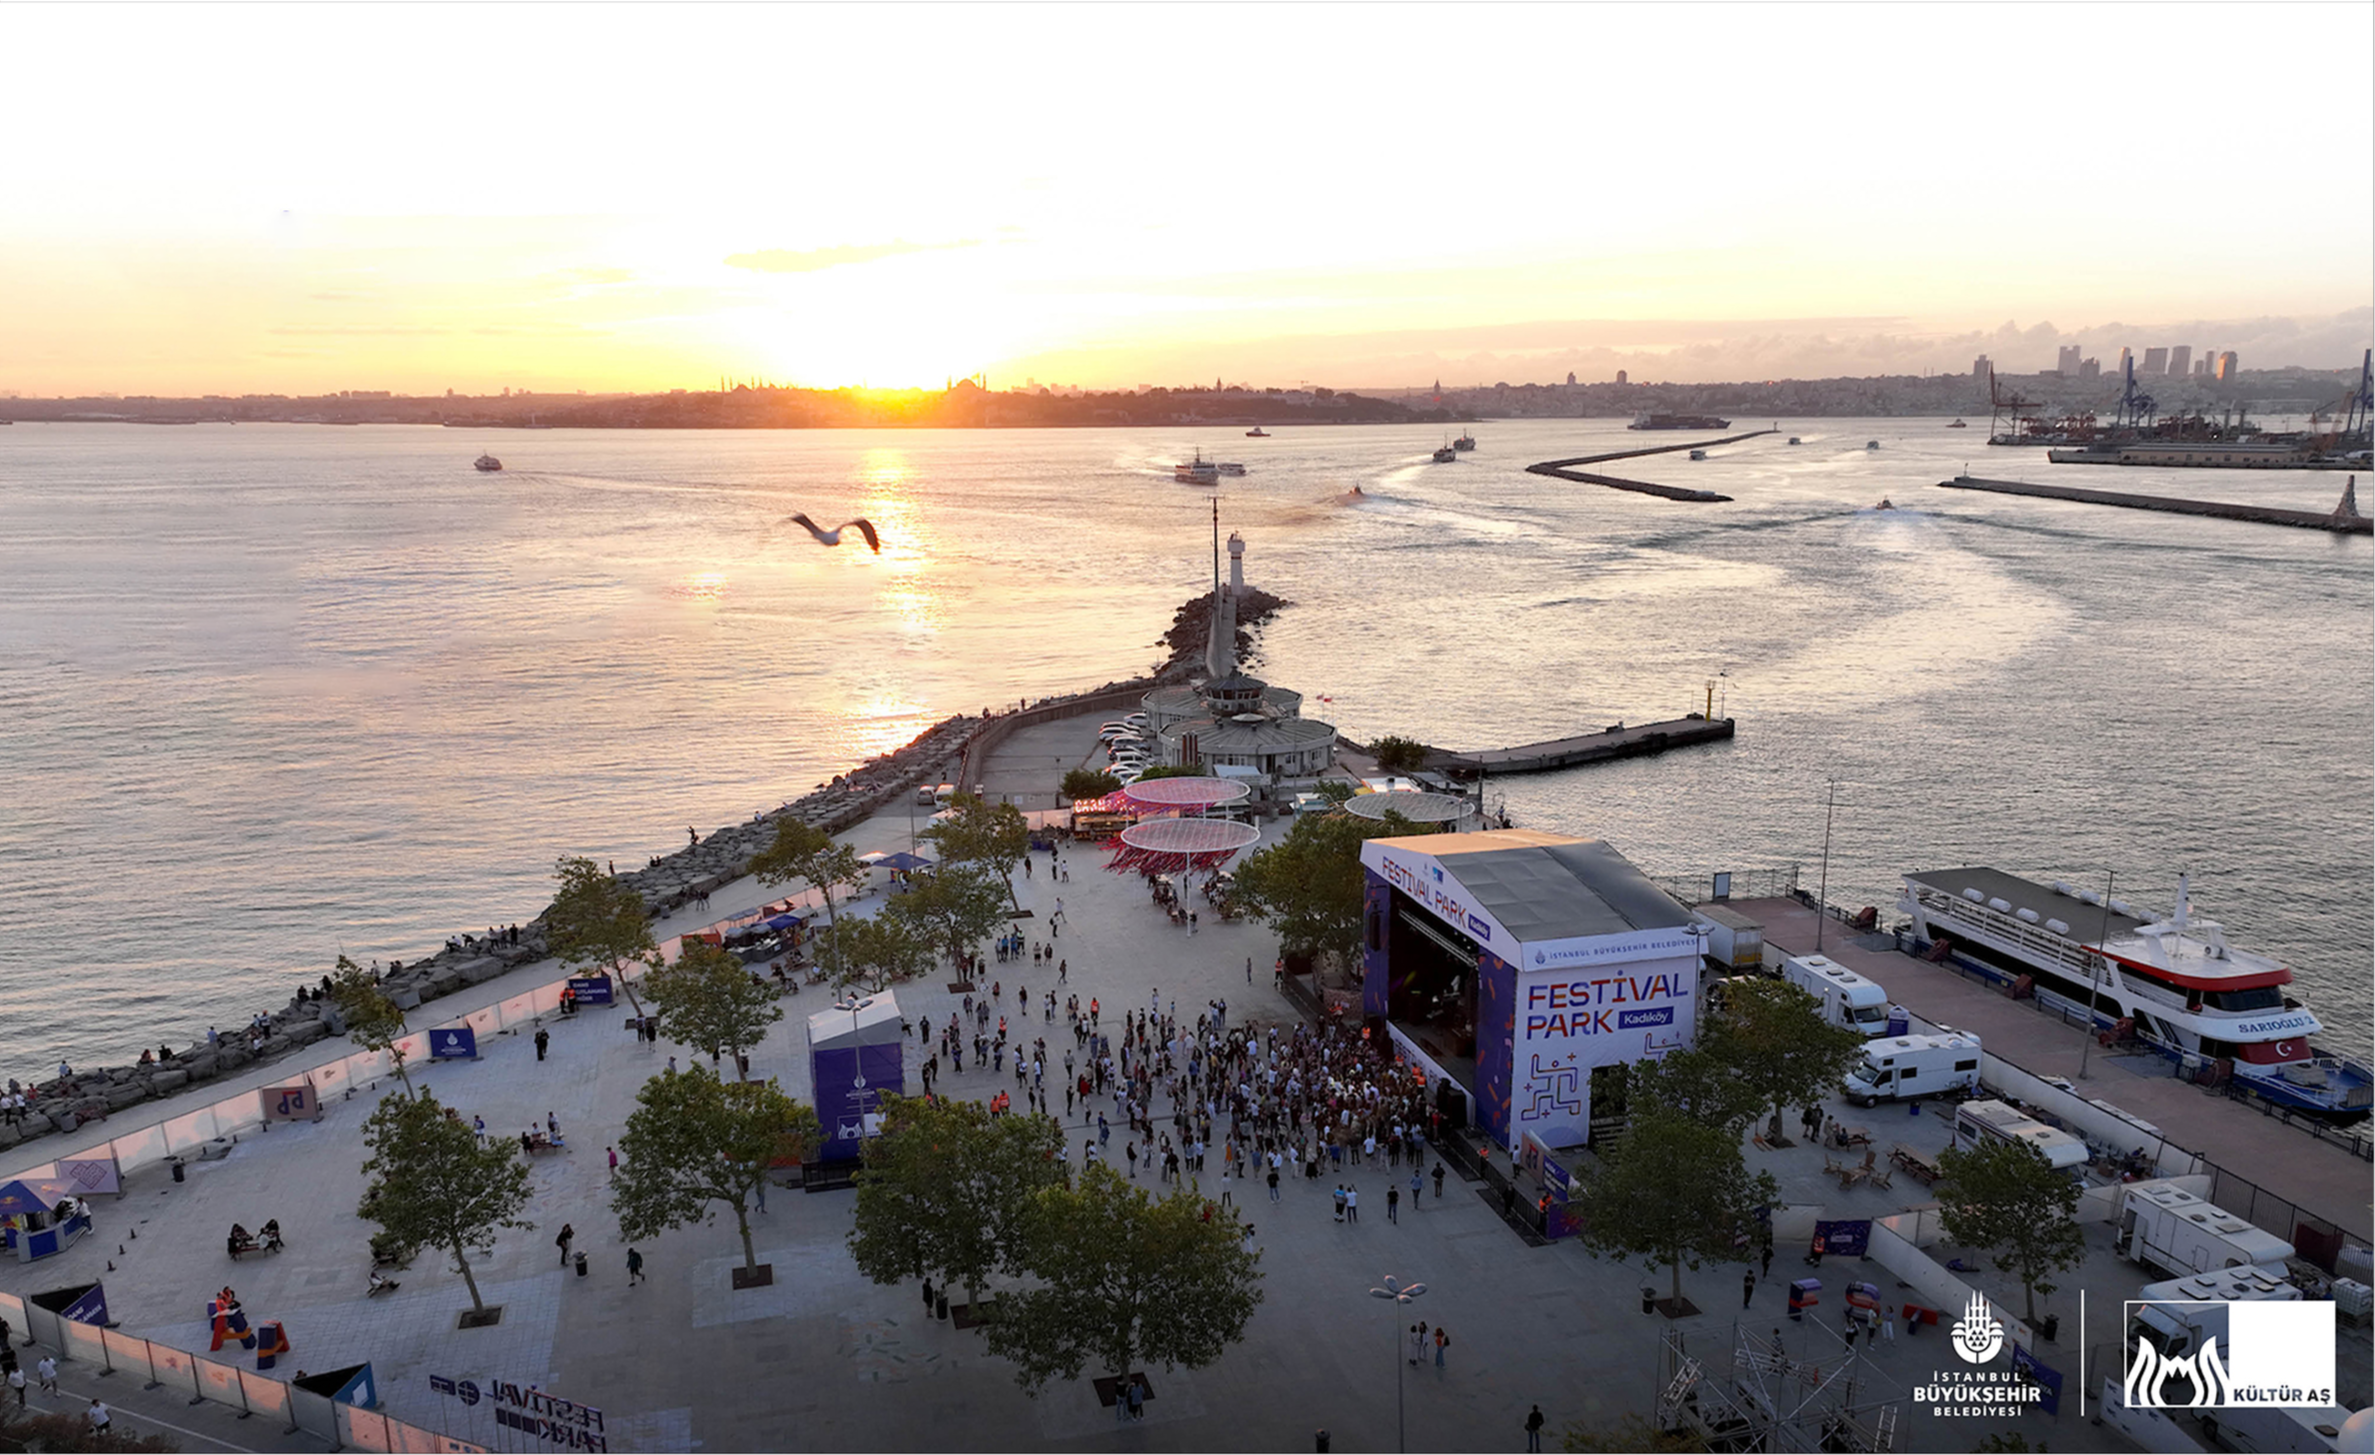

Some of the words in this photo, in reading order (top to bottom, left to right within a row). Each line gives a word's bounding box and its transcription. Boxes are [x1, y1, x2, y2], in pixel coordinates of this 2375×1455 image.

[1382, 856, 1433, 907] FESTİVAL
[1435, 890, 1467, 928] PARK
[1550, 950, 1590, 960] İSTANBUL
[1594, 943, 1648, 955] BÜYÜKŞEHİR
[1651, 939, 1698, 950] BELEDİYES
[1528, 970, 1689, 1010] FESTİVAL
[1527, 1008, 1614, 1040] PARK
[1624, 1011, 1669, 1026] Kadıköy
[2238, 1016, 2304, 1034] SARIOĞLU
[2304, 1015, 2315, 1026] 2
